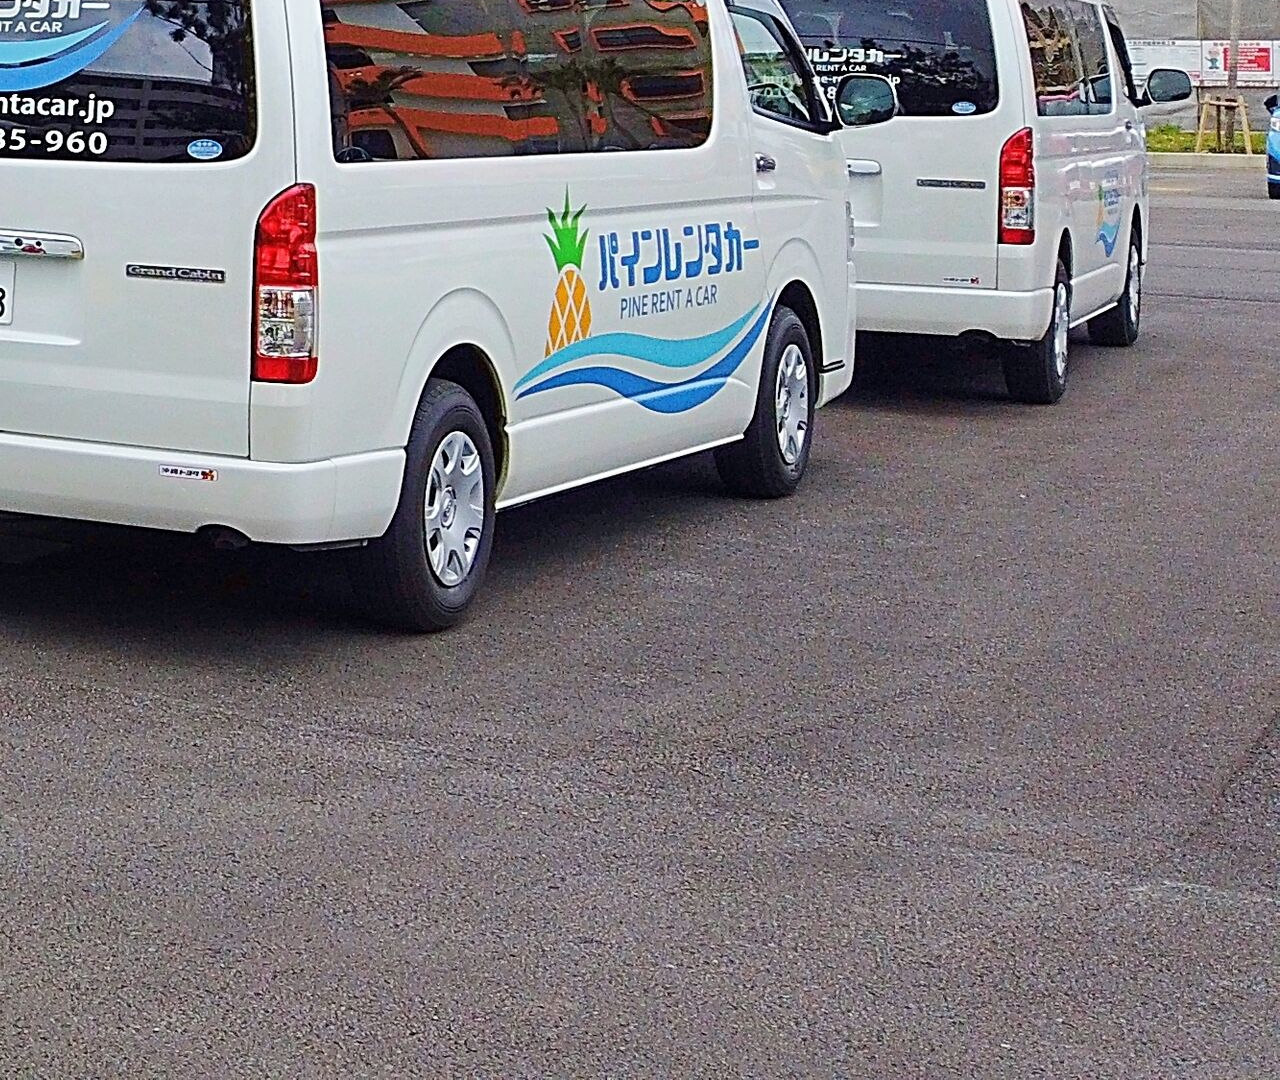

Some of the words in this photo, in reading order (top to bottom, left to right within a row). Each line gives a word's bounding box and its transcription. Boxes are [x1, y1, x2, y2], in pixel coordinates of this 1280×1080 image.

[14, 21, 27, 33] A
[30, 21, 62, 33] CAR
[816, 64, 841, 72] RENT
[841, 64, 848, 72] A
[849, 64, 867, 72] CAR
[598, 221, 760, 291] パインレンタカー
[128, 265, 177, 277] Grand
[178, 269, 223, 281] Cabin
[620, 295, 648, 319] PINE
[651, 290, 683, 314] RENT
[685, 287, 694, 309] A
[695, 284, 718, 305] CAR
